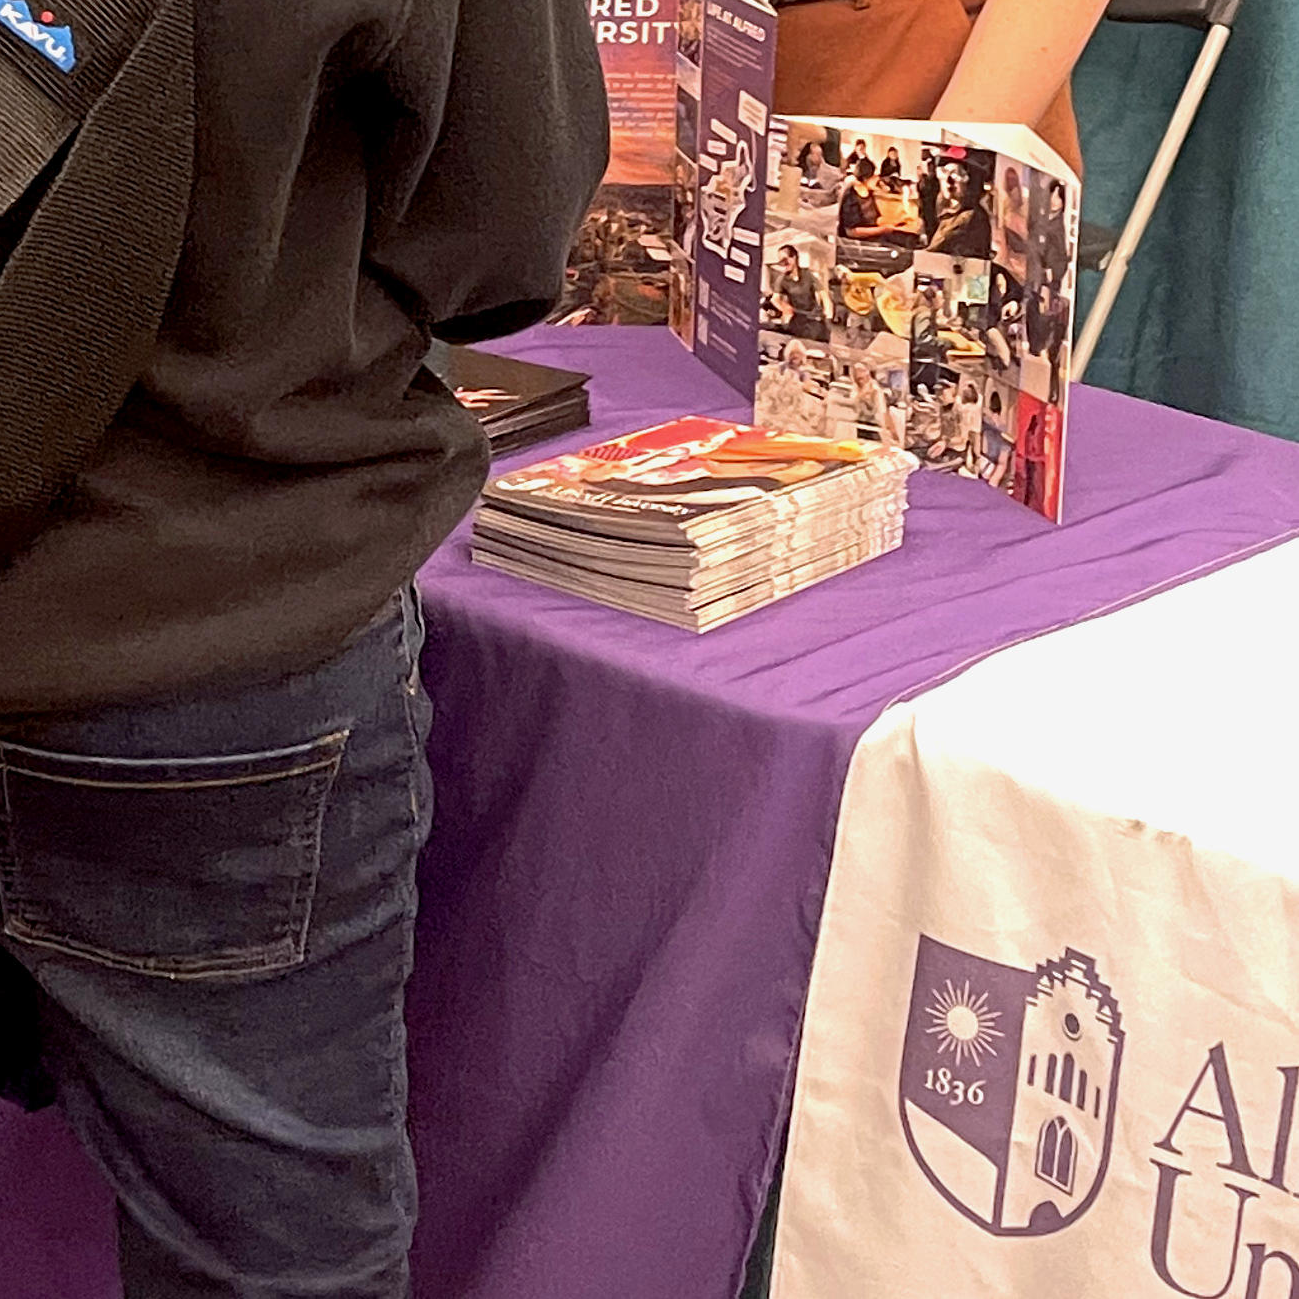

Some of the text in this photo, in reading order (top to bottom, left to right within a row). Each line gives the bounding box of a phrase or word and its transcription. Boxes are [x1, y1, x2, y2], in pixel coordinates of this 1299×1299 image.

[0, 4, 66, 61] KAVU
[590, 20, 679, 45] RSIT
[923, 1067, 985, 1106] 1836
